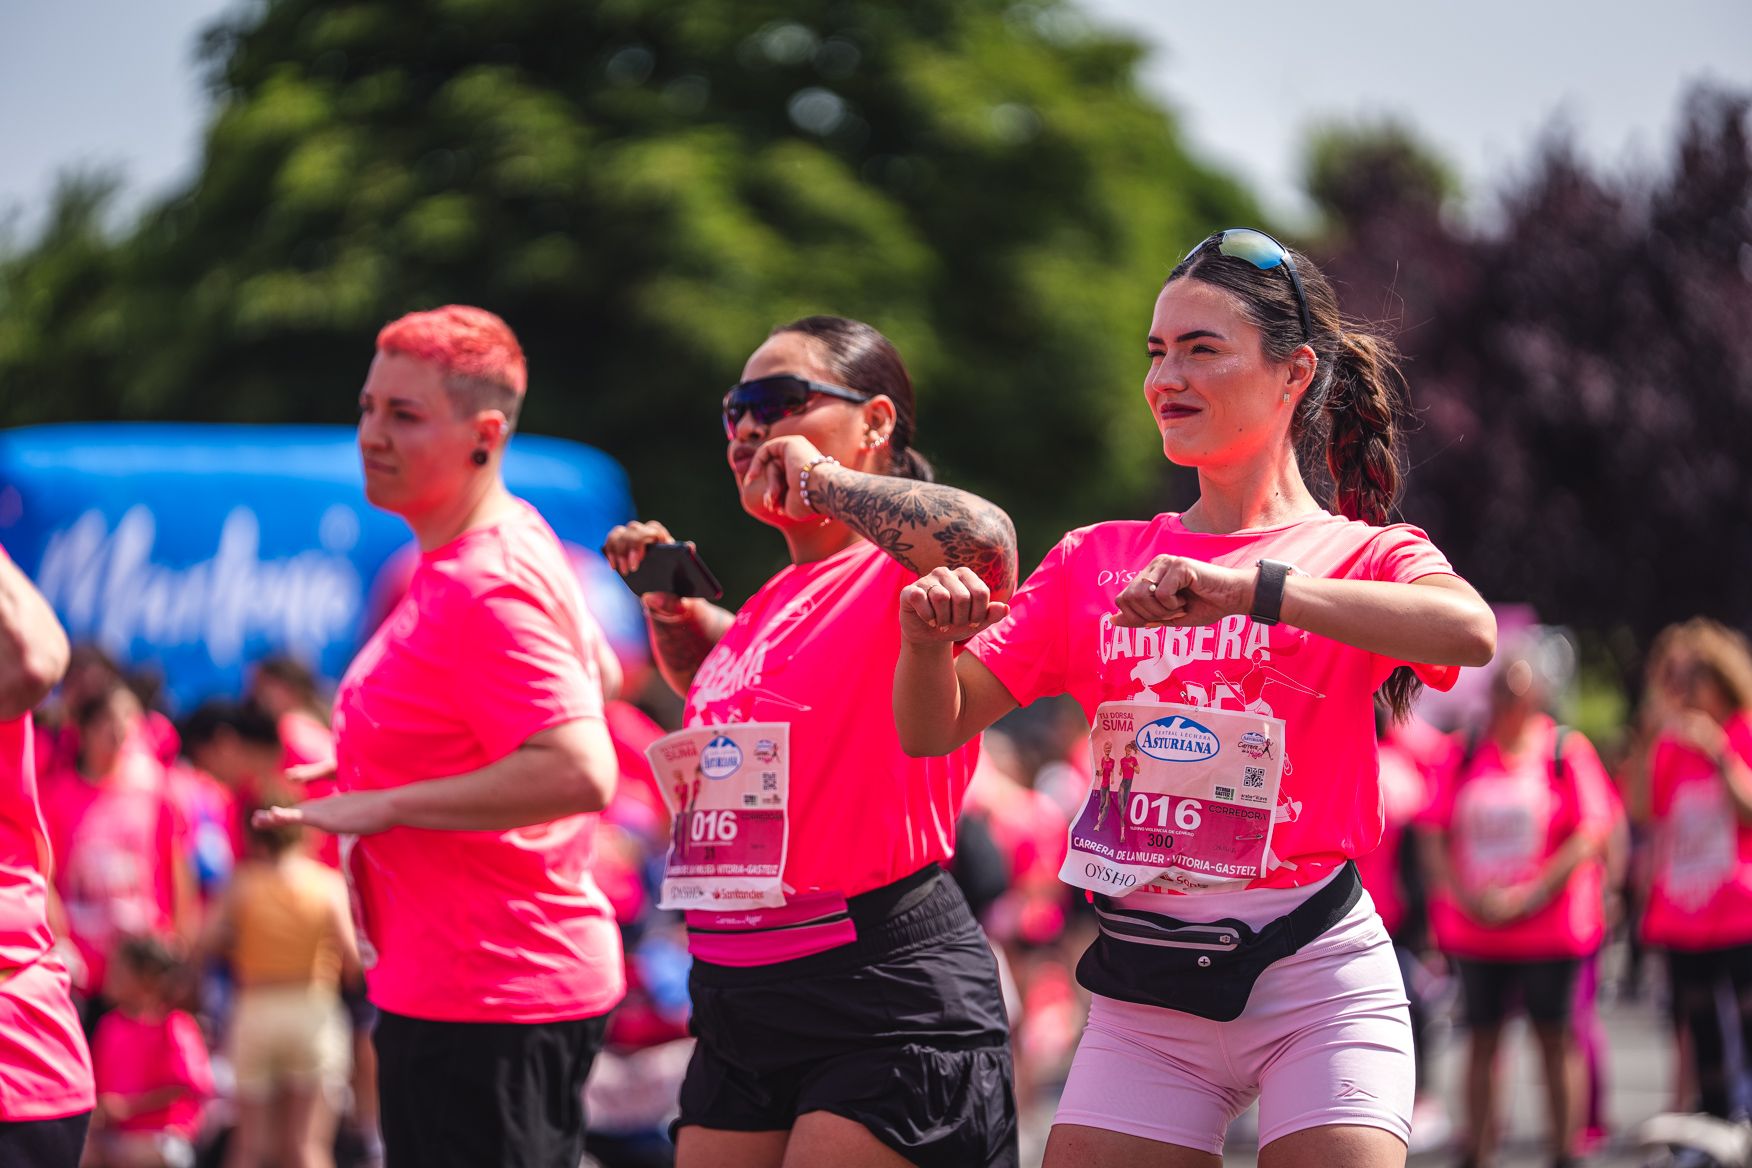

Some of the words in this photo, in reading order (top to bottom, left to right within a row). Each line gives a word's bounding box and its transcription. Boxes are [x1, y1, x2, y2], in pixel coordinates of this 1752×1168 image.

[1097, 569, 1138, 586] OYS
[1103, 719, 1134, 733] SUMA
[1110, 711, 1134, 720] DORSAL
[1142, 730, 1213, 755] ASTURIANA
[1129, 793, 1203, 831] 016
[1208, 804, 1267, 820] CORREDORA
[690, 809, 738, 841] 016
[1147, 833, 1174, 848] 300
[1074, 836, 1115, 858] CARRERA
[1116, 850, 1127, 861] DE
[1136, 851, 1164, 864] MUJER
[1171, 853, 1257, 877] VITORIA-GASTEIZ
[1085, 862, 1137, 888] OYSHO
